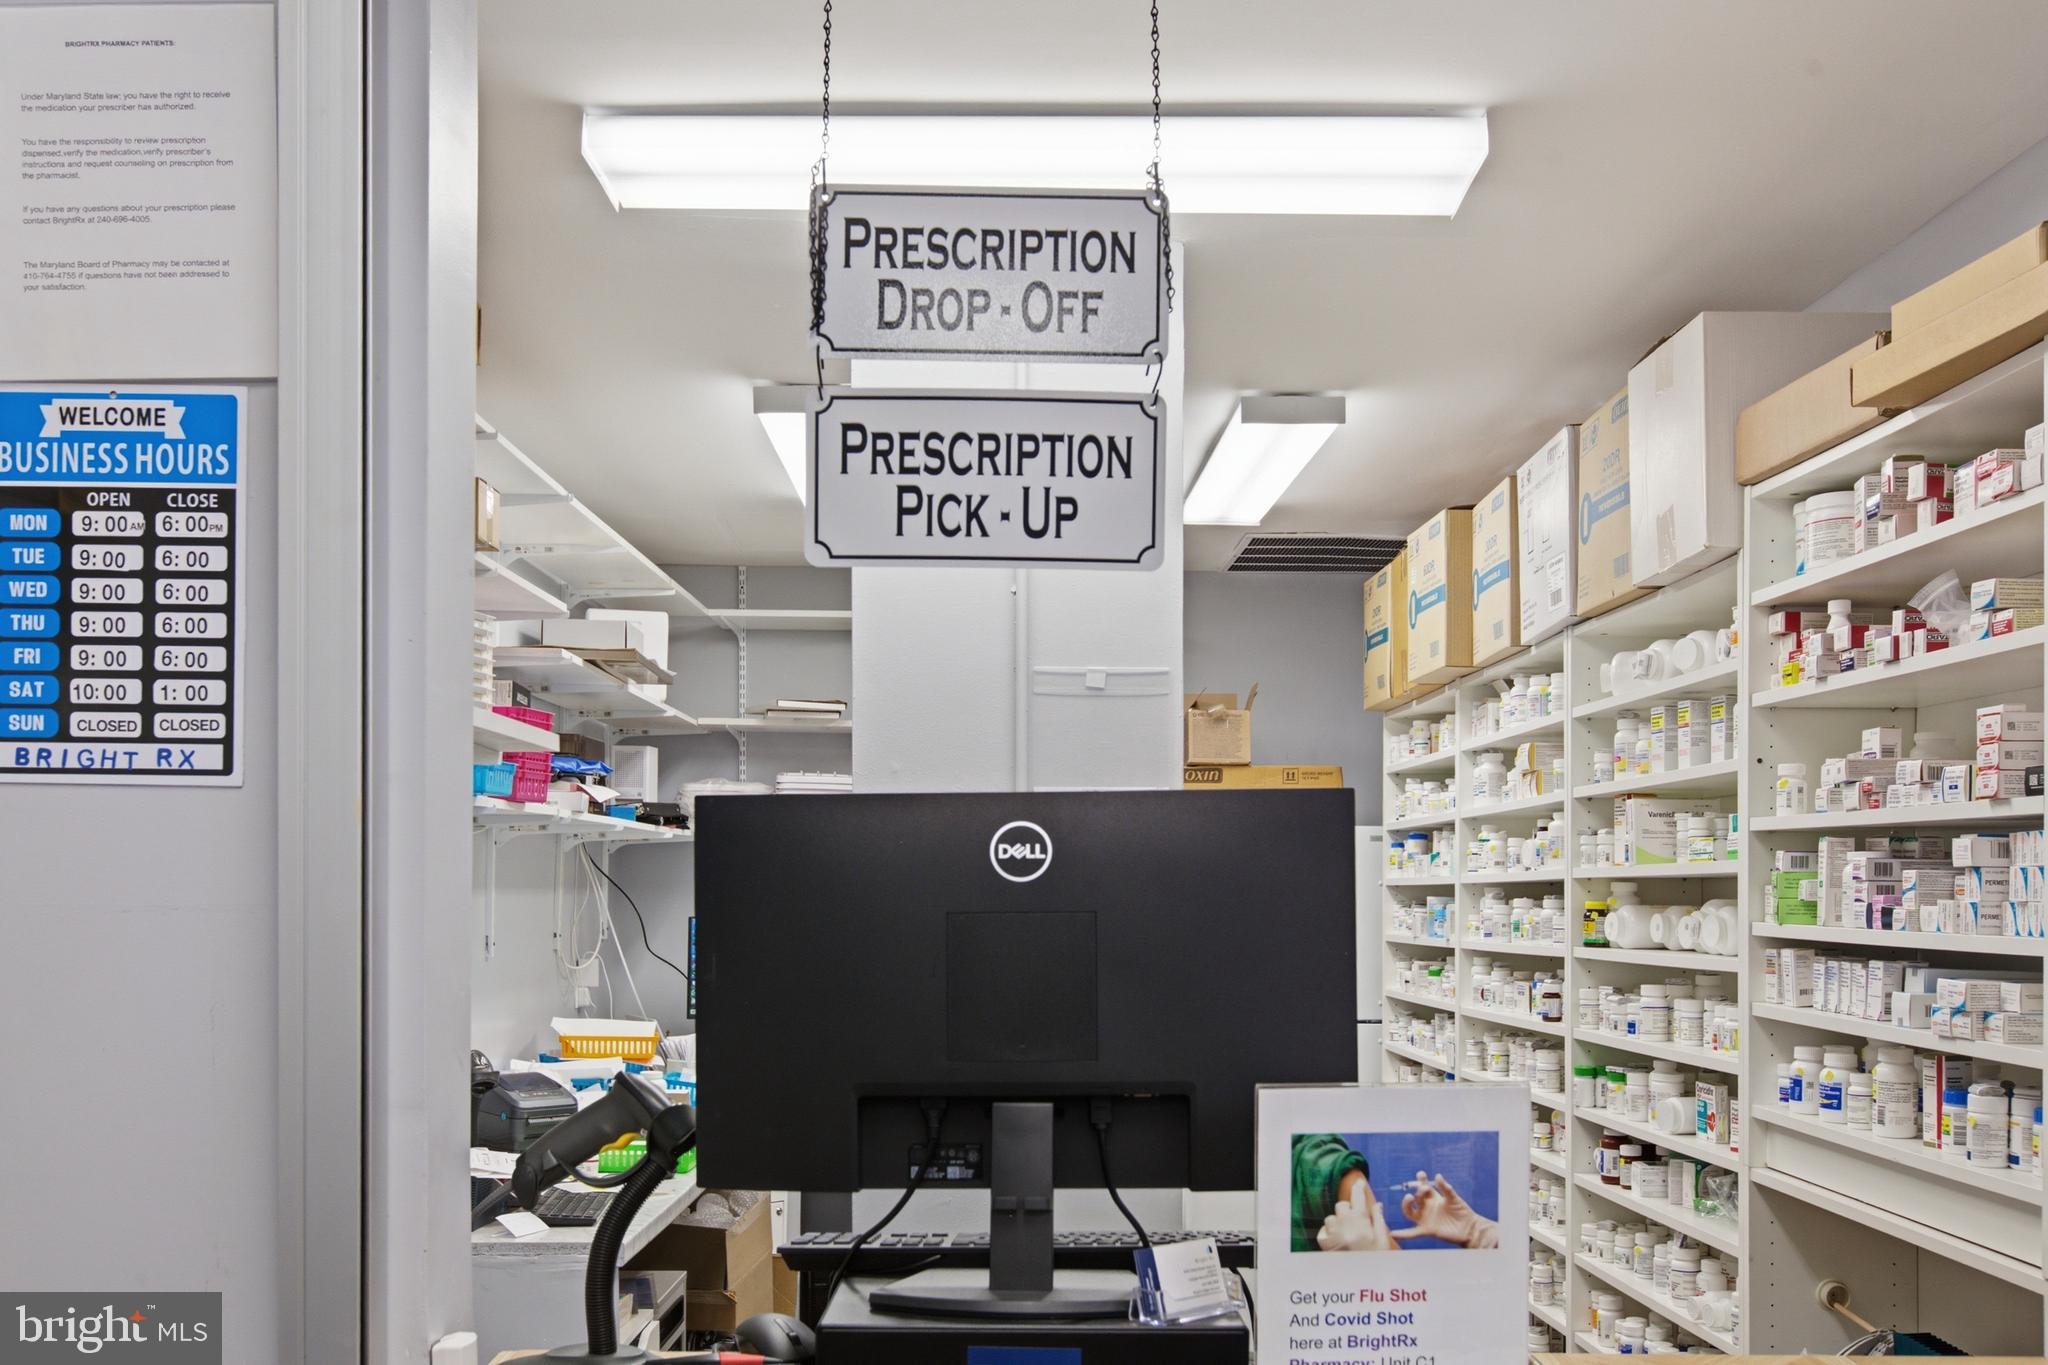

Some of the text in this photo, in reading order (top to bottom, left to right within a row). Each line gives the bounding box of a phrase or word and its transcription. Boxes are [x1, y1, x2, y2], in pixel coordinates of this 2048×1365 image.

[21, 92, 44, 100] Under
[46, 92, 82, 102] Maryland
[84, 92, 104, 100] State
[174, 90, 191, 100] right
[35, 104, 76, 112] medication
[98, 104, 136, 112] prescriber
[38, 138, 58, 146] have
[60, 137, 72, 145] the
[74, 136, 122, 146] responsibility
[161, 136, 206, 145] prescription
[22, 160, 66, 168] instructions
[68, 160, 82, 168] and
[84, 160, 112, 169] request
[114, 159, 156, 168] counseling
[170, 159, 214, 168] prescription
[216, 158, 234, 167] from
[22, 204, 28, 212] If
[30, 206, 44, 214] you
[46, 204, 65, 212] have
[66, 205, 80, 214] any
[82, 204, 118, 212] questions
[121, 204, 142, 212] about
[164, 203, 208, 212] prescription
[210, 202, 236, 212] please
[23, 216, 50, 224] contact
[52, 216, 86, 226] BrightRx
[842, 216, 1137, 274] PRESCRIPTION
[40, 261, 76, 270] Maryland
[78, 260, 100, 268] Board
[102, 260, 110, 268] of
[112, 260, 150, 269] Pharmacy
[152, 260, 168, 268] may
[170, 259, 180, 267] be
[182, 258, 220, 267] contacted
[78, 272, 84, 280] if
[85, 272, 122, 280] questions
[158, 270, 178, 278] been
[180, 270, 220, 278] addressed
[24, 284, 40, 293] your
[59, 406, 166, 427] WELCOME
[0, 441, 230, 476] BUSINESS HOURS
[840, 422, 1133, 480] PRESCRIPTION
[86, 492, 218, 508] OPEN CLOSE
[10, 514, 48, 532] MON
[130, 522, 145, 531] AM
[210, 524, 224, 532] PM
[12, 548, 45, 564] TUE
[8, 581, 48, 598] WED
[10, 614, 45, 631] THU
[14, 648, 41, 664] FRI
[9, 681, 45, 698] SAT
[8, 714, 220, 732] SUN CLOSED CLOSED
[15, 746, 196, 771] BRIGHT RX
[998, 842, 1046, 860] DELL
[1290, 1288, 1428, 1308] Get your Flu Shot
[1290, 1312, 1414, 1328] And Covid Shot
[1290, 1334, 1418, 1352] here at BrightRx
